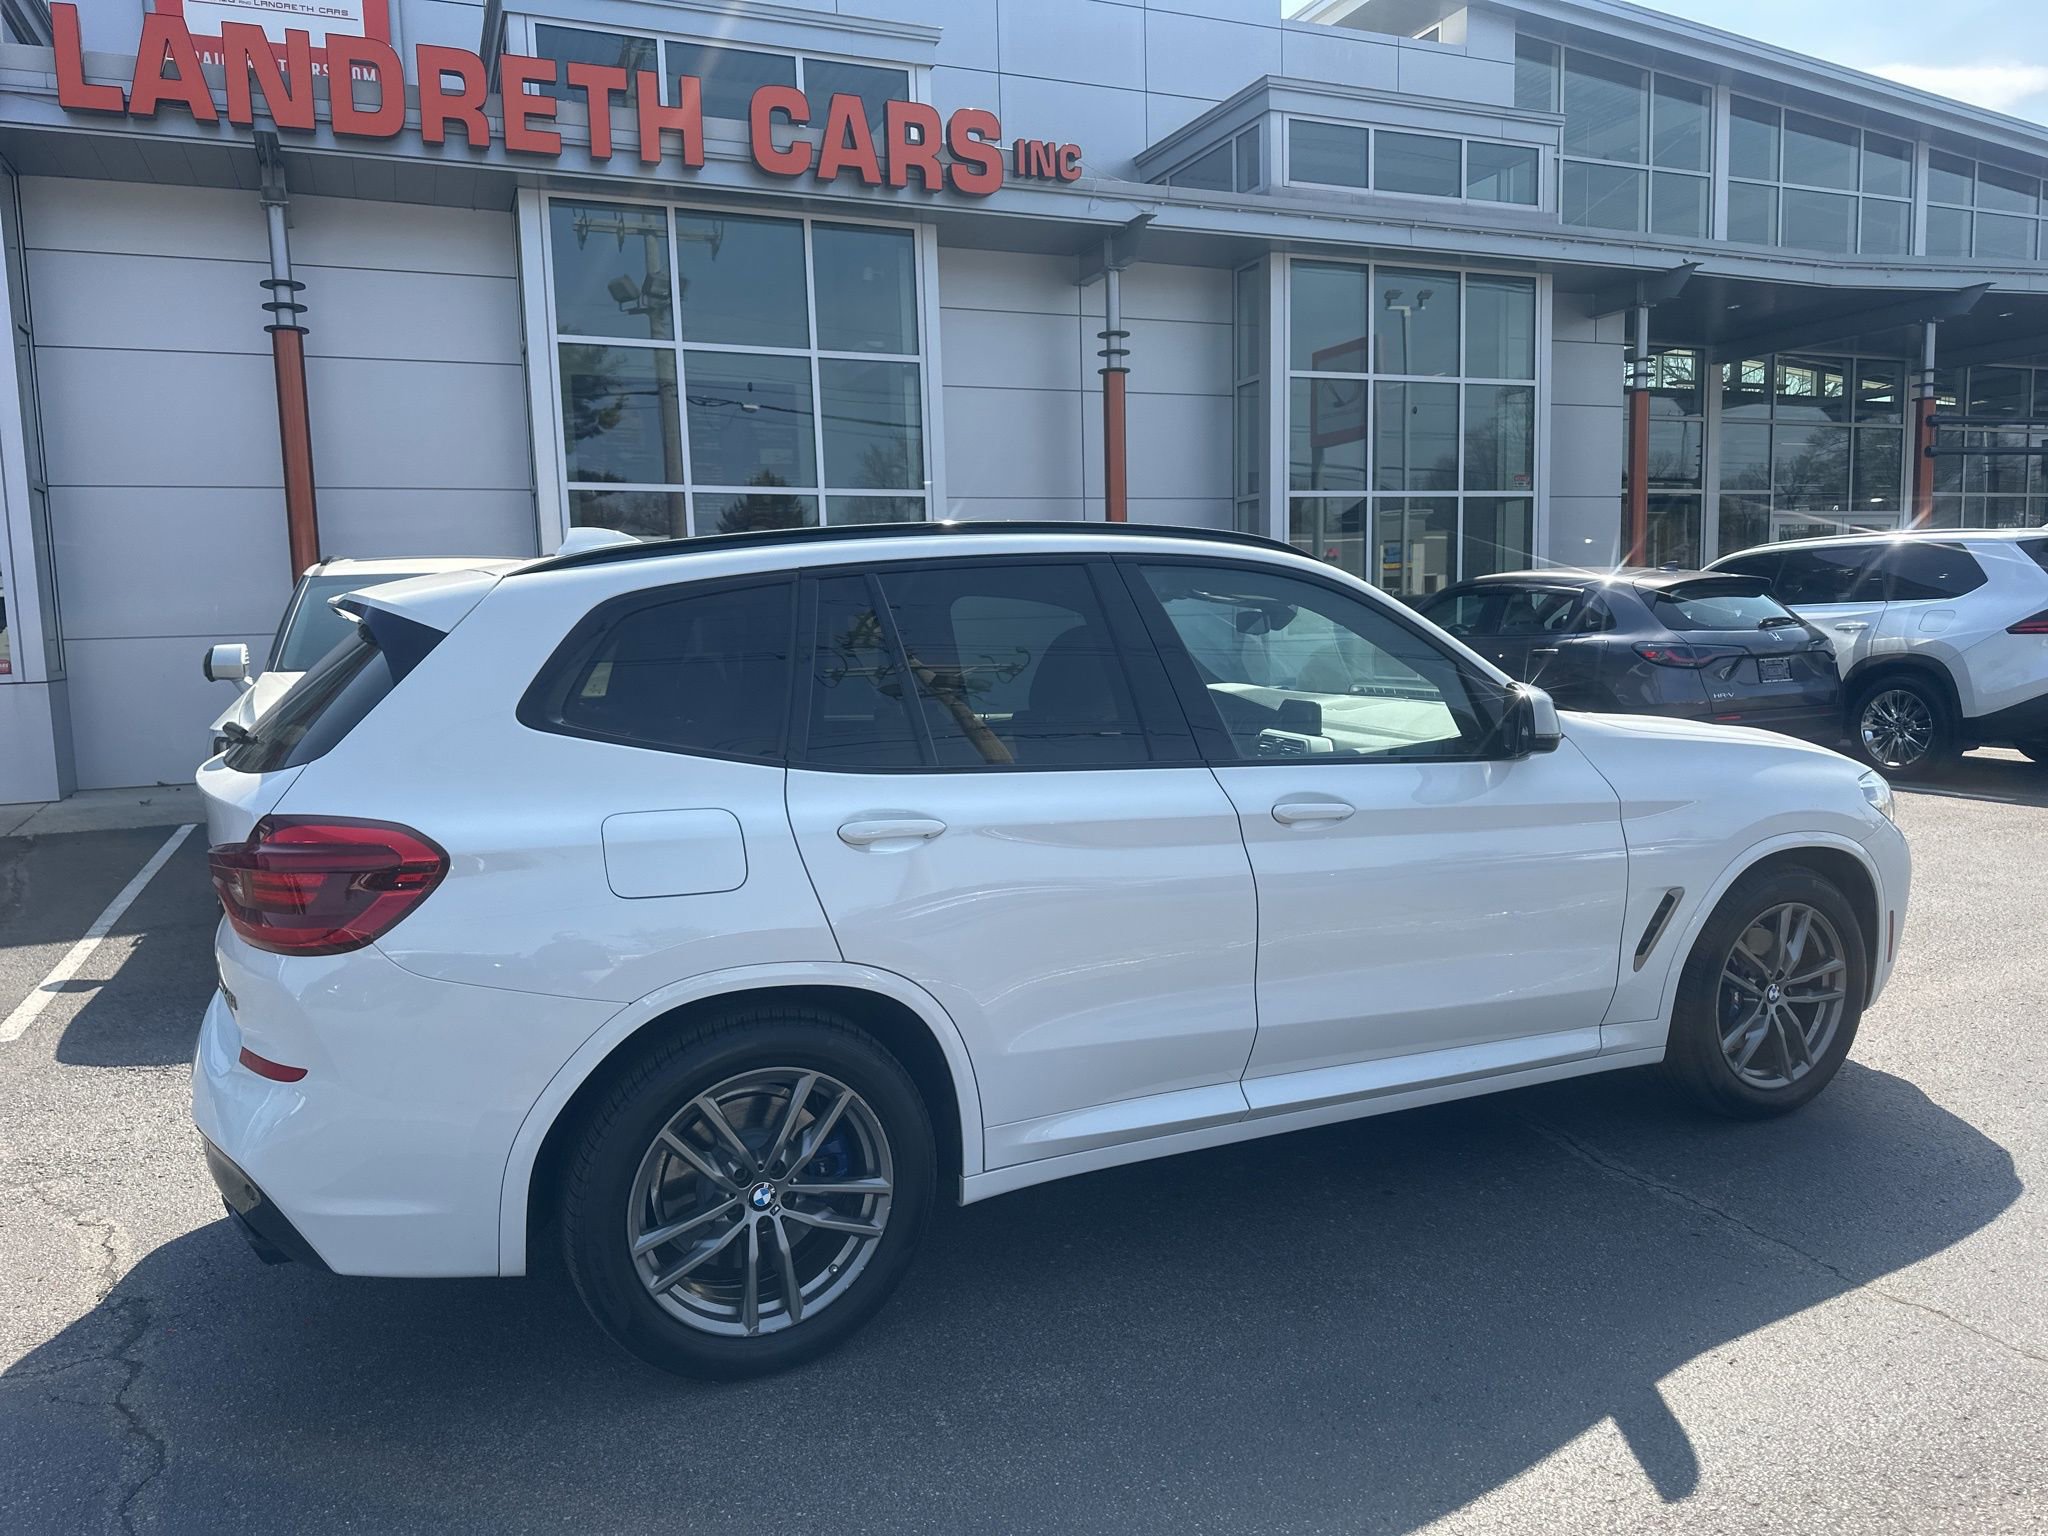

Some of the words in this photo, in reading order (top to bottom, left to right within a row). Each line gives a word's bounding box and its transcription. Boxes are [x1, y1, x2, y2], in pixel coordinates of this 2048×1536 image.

[318, 6, 349, 16] CARS
[52, 2, 705, 169] LANDRETH
[749, 84, 1004, 197] CARS
[1012, 138, 1083, 183] INC
